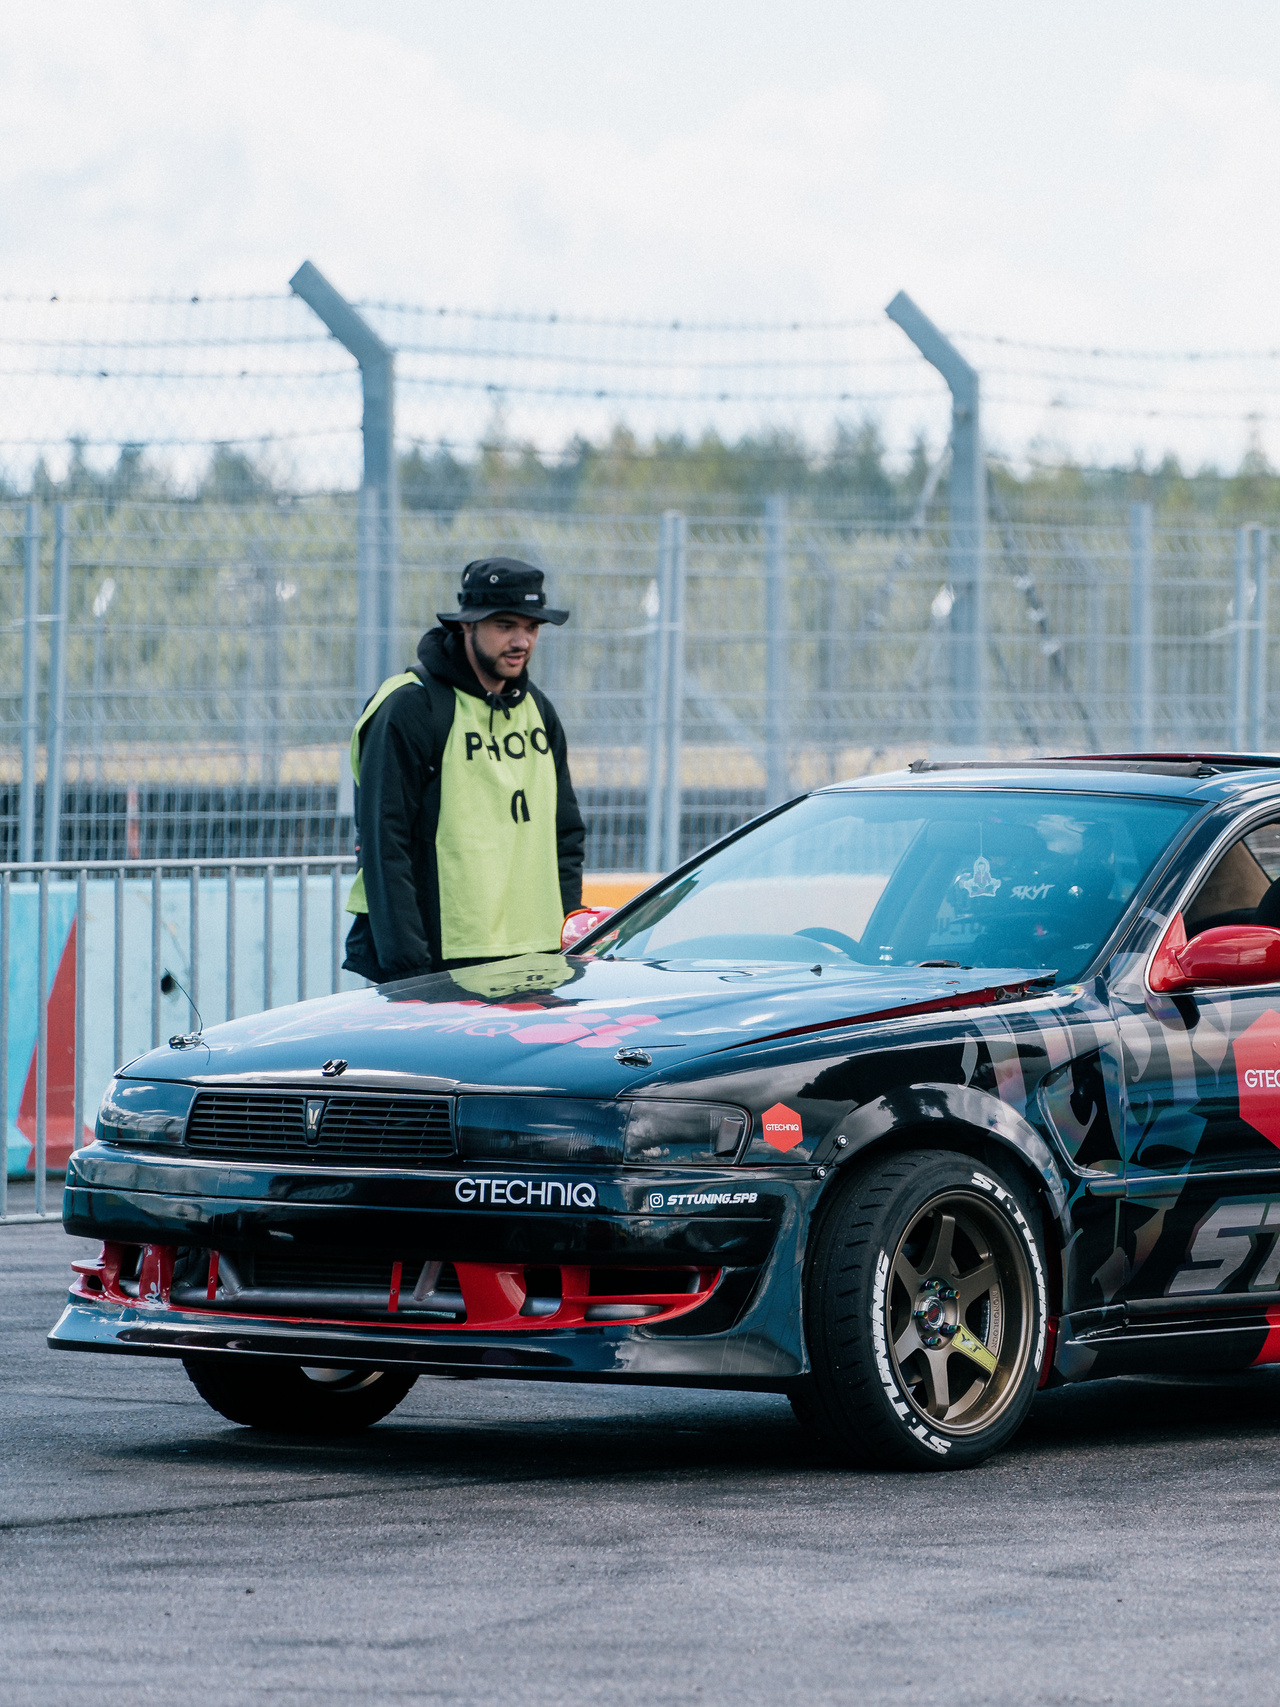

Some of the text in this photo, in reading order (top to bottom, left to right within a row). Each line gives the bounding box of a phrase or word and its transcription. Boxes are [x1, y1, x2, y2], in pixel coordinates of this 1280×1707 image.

[465, 727, 550, 762] PHOO
[765, 1123, 799, 1132] GTECHNIQ
[454, 1177, 596, 1208] GTECHNIQ
[666, 1192, 758, 1206] STTUNING.SPB
[991, 1290, 1001, 1349] MONOBLOCK
